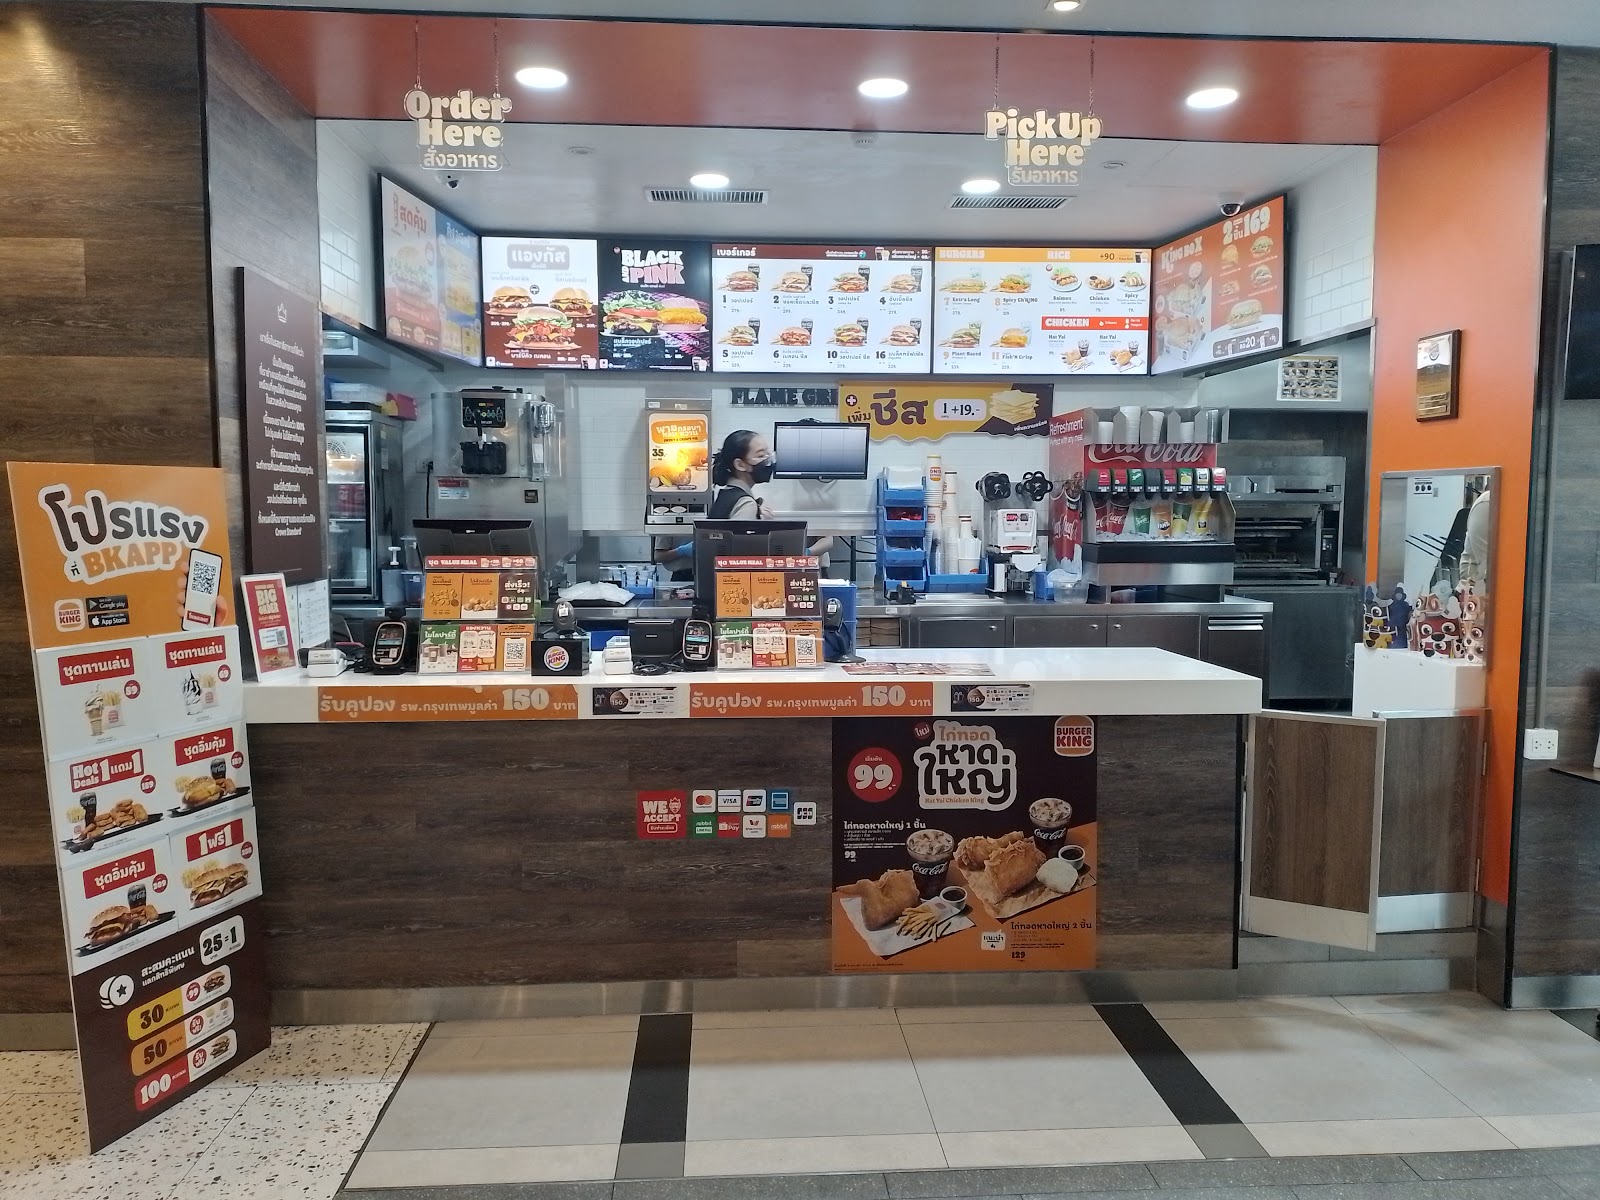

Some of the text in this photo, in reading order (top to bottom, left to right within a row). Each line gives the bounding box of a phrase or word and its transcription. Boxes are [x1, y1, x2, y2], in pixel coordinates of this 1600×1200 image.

[405, 90, 512, 120] Order
[418, 118, 501, 147] Here
[986, 108, 1101, 146] Pick Up
[424, 145, 498, 169] สั่งอาหาร
[1007, 139, 1084, 166] Here
[1011, 166, 1078, 184] รับอาหาร
[1223, 221, 1233, 245] 2
[621, 249, 684, 268] BLACK
[716, 247, 757, 257] เบอร์เกอร์
[629, 263, 685, 284] PINK
[722, 294, 727, 303] 1
[773, 295, 780, 304] 2
[828, 296, 834, 305] 3
[879, 296, 886, 305] 4
[1045, 318, 1090, 327] CHICKEN
[722, 349, 728, 358] 5
[773, 350, 780, 358] 6
[827, 351, 838, 359] 10
[875, 351, 886, 359] 16
[730, 387, 798, 406] FLAME
[870, 388, 928, 426] ชีส
[1049, 416, 1084, 436] Refreshment
[44, 490, 204, 552] โปรแรง
[81, 541, 177, 579] BKAPP
[70, 560, 81, 577] ที่
[504, 579, 531, 588] ส่งเร็ว!
[790, 578, 814, 587] ส่งเร็ว!
[58, 609, 81, 617] BURGER
[59, 616, 82, 625] KING
[101, 617, 127, 626] App Store
[168, 641, 224, 662] ชุดทานเล่น
[547, 650, 565, 659] BURGER
[547, 655, 566, 664] KING
[63, 658, 131, 681] ชุดทานเล่น
[320, 695, 396, 718] รับคูปอง
[502, 688, 549, 711] 150
[553, 700, 577, 711] บาท
[691, 691, 762, 714] รับคูปอง
[861, 685, 906, 707] 150
[909, 698, 932, 708] บาท
[914, 724, 930, 738] ใหม่
[938, 725, 991, 742] ไก่ทอด
[1056, 727, 1092, 736] BURGER
[183, 736, 226, 758] ชุดอิ่มคุ้ม
[1056, 736, 1092, 748] KING
[935, 744, 998, 765] หาด
[72, 764, 99, 779] Hot
[919, 752, 1012, 805] ใหญ่
[74, 776, 100, 789] Deals
[643, 800, 669, 815] WE
[797, 807, 814, 820] JCB
[643, 813, 682, 823] ACCEPT
[843, 820, 905, 831] ไก่ทอดหาดใหญ่
[913, 818, 927, 829] ชิ้น
[728, 824, 740, 833] Pay
[844, 850, 857, 859] 99
[95, 862, 146, 889] ชุดอิ่มคุ้ม
[1011, 921, 1070, 931] ไก่ทอดหาดใหญ่
[1080, 919, 1093, 929] ชิ้น
[141, 946, 195, 978] สะสมคะแนน
[1011, 951, 1026, 959] 129
[140, 1004, 164, 1030] 30
[143, 1038, 168, 1065] 50
[141, 1073, 172, 1105] 100
